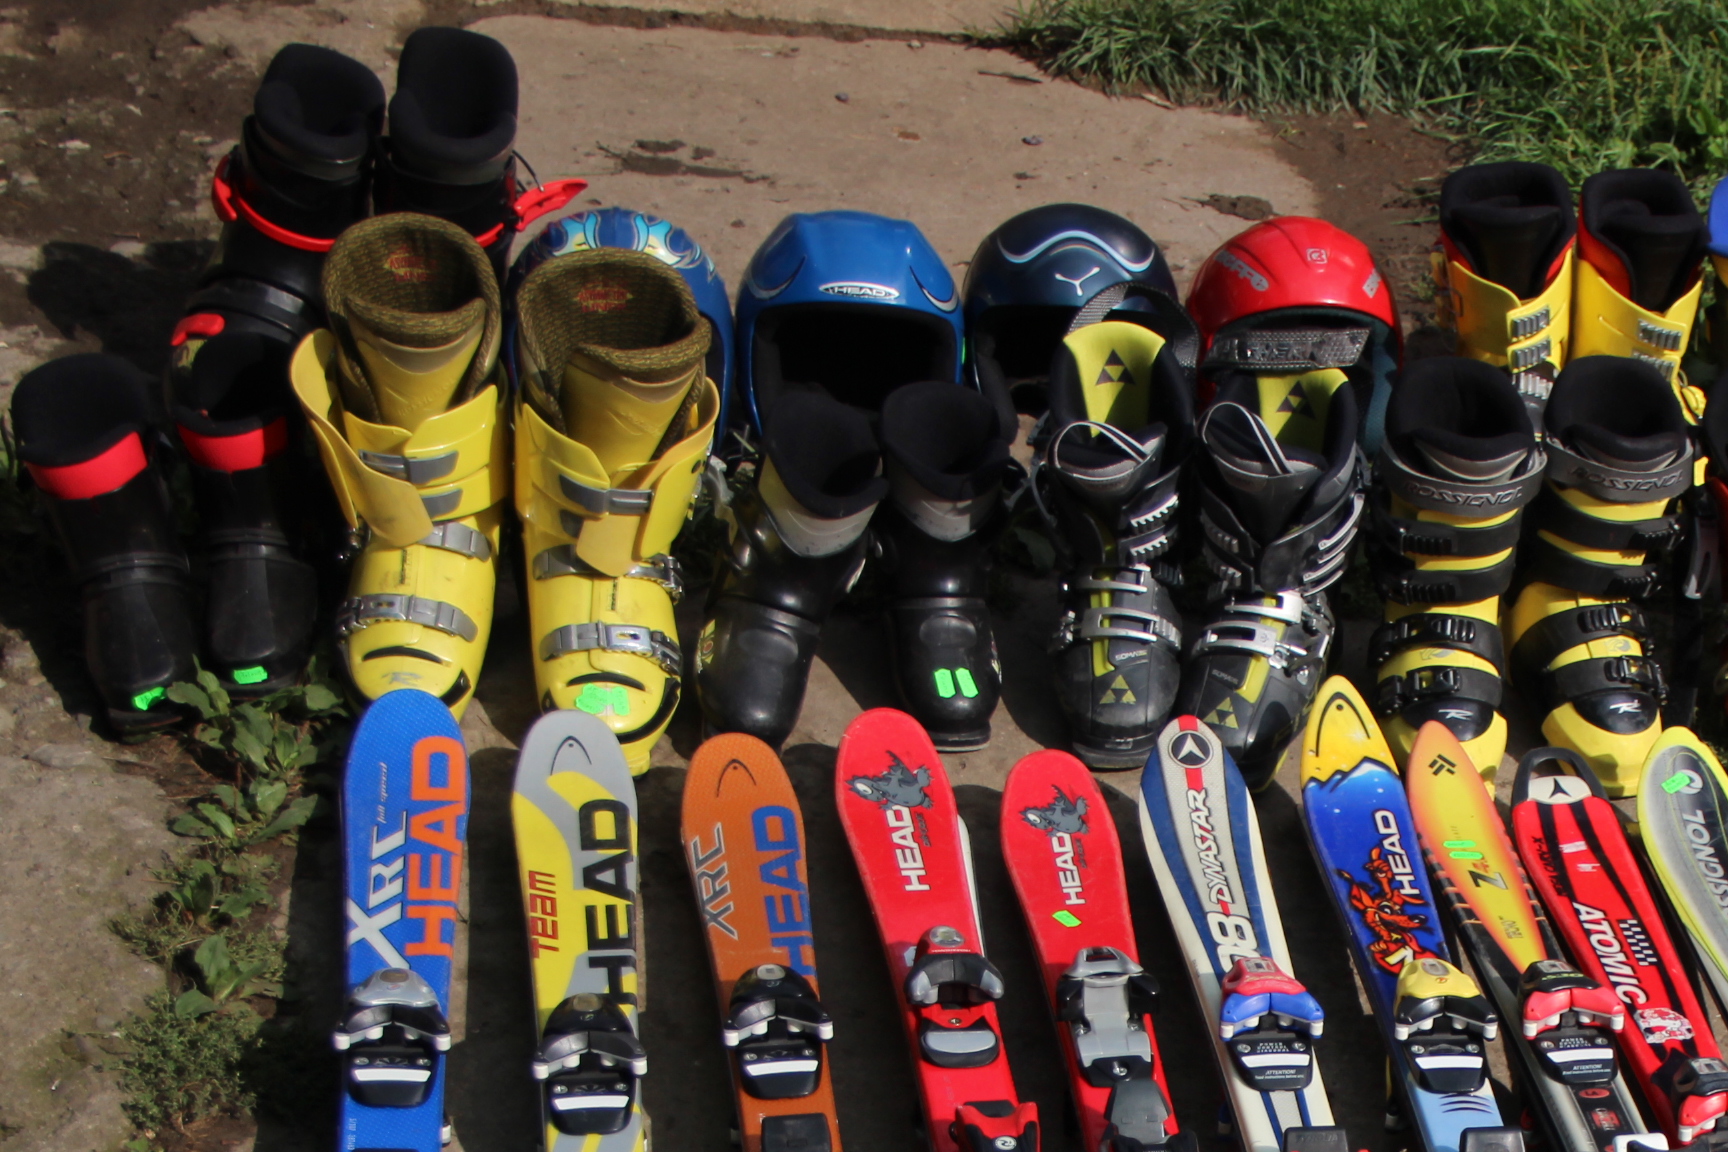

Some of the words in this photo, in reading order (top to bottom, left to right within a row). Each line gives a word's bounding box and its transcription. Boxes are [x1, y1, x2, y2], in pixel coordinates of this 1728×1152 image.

[833, 285, 887, 297] HEAD
[1402, 480, 1524, 508] ROSSIGNOL
[1569, 465, 1684, 493] ROSSIGNOL
[404, 735, 468, 961] HEAD
[750, 804, 818, 976] HEAD
[886, 804, 931, 892] HEAD
[1051, 831, 1086, 905] HEAD
[1187, 787, 1236, 905] DYNASTAR
[1372, 807, 1421, 895] HEAD
[578, 799, 639, 1004] HEAD
[1572, 901, 1648, 1005] ATOMIC
